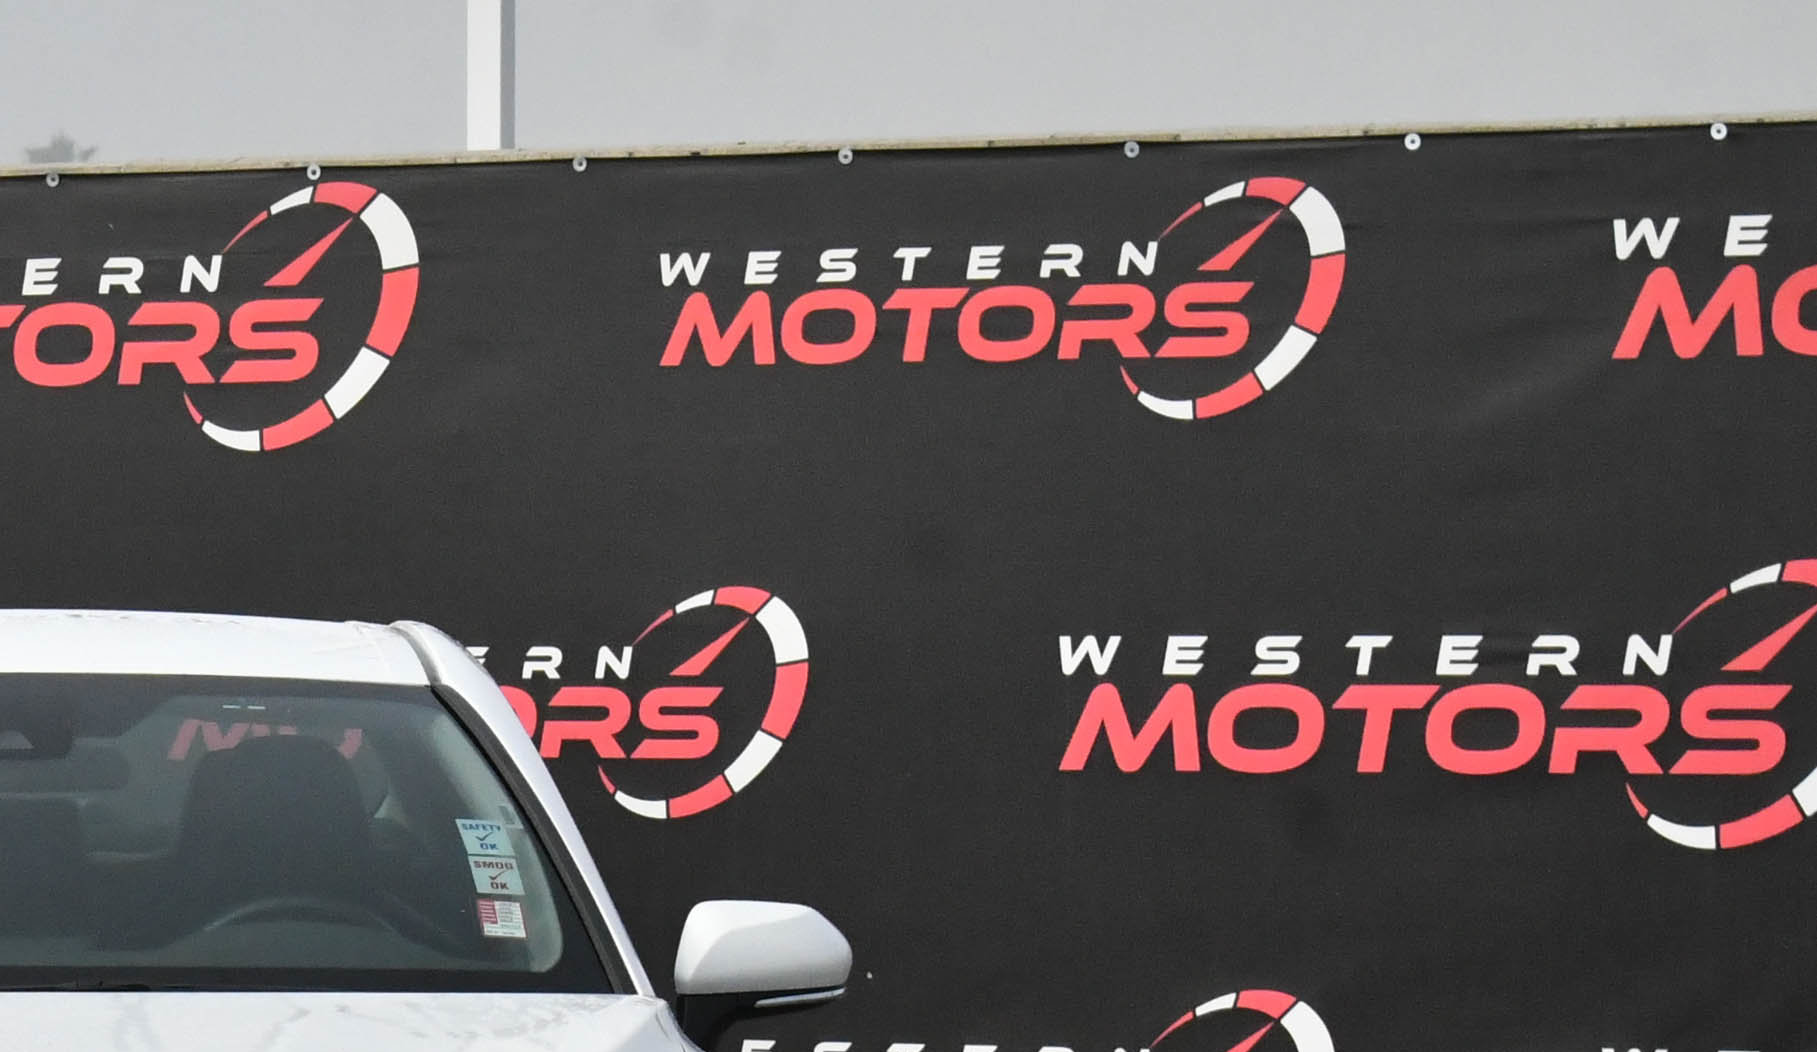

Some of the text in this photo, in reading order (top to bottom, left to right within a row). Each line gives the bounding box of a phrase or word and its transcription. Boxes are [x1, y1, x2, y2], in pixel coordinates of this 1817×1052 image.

[659, 241, 1160, 287] WESTERN
[659, 280, 1256, 368] MOTORS
[1058, 634, 1674, 676] WESTERN
[499, 684, 725, 760] RS
[1058, 682, 1793, 776] MOTORS
[461, 823, 502, 832] SAFETY
[480, 842, 499, 850] OK
[473, 860, 514, 870] SMOG
[490, 881, 509, 890] OK
